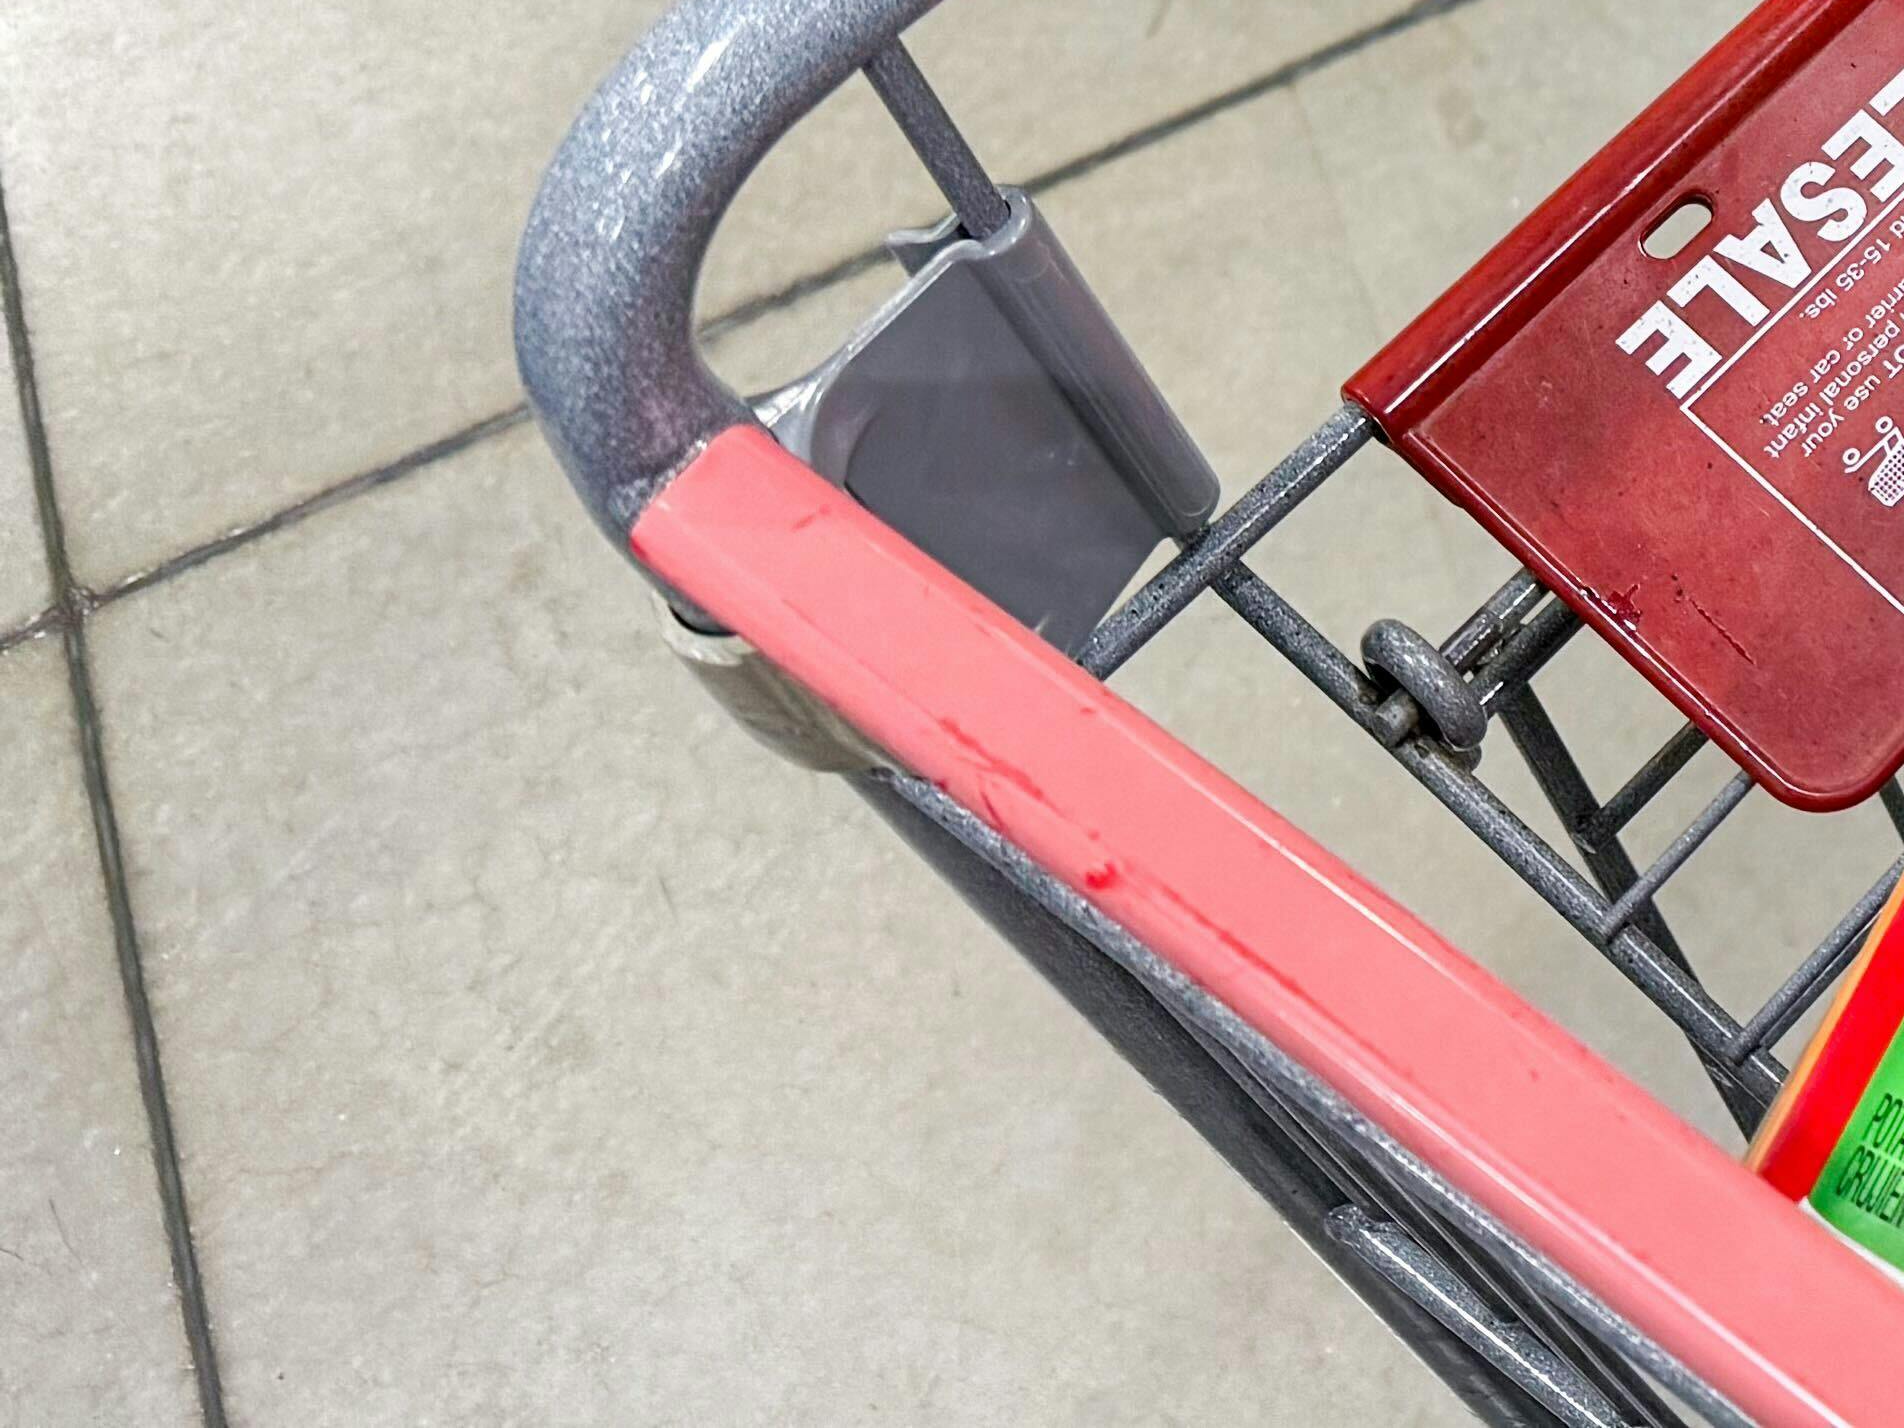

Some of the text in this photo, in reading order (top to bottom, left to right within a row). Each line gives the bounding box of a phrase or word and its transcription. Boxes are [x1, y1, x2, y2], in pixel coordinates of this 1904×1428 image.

[1835, 238, 1891, 292] 15-35
[1798, 288, 1839, 320] lbs.
[1843, 327, 1865, 351] or
[1809, 349, 1841, 384] car
[1819, 319, 1900, 406] personal
[1759, 381, 1810, 427] seat.
[1844, 373, 1881, 411] use
[1764, 402, 1825, 458] infant
[1801, 407, 1845, 458] your
